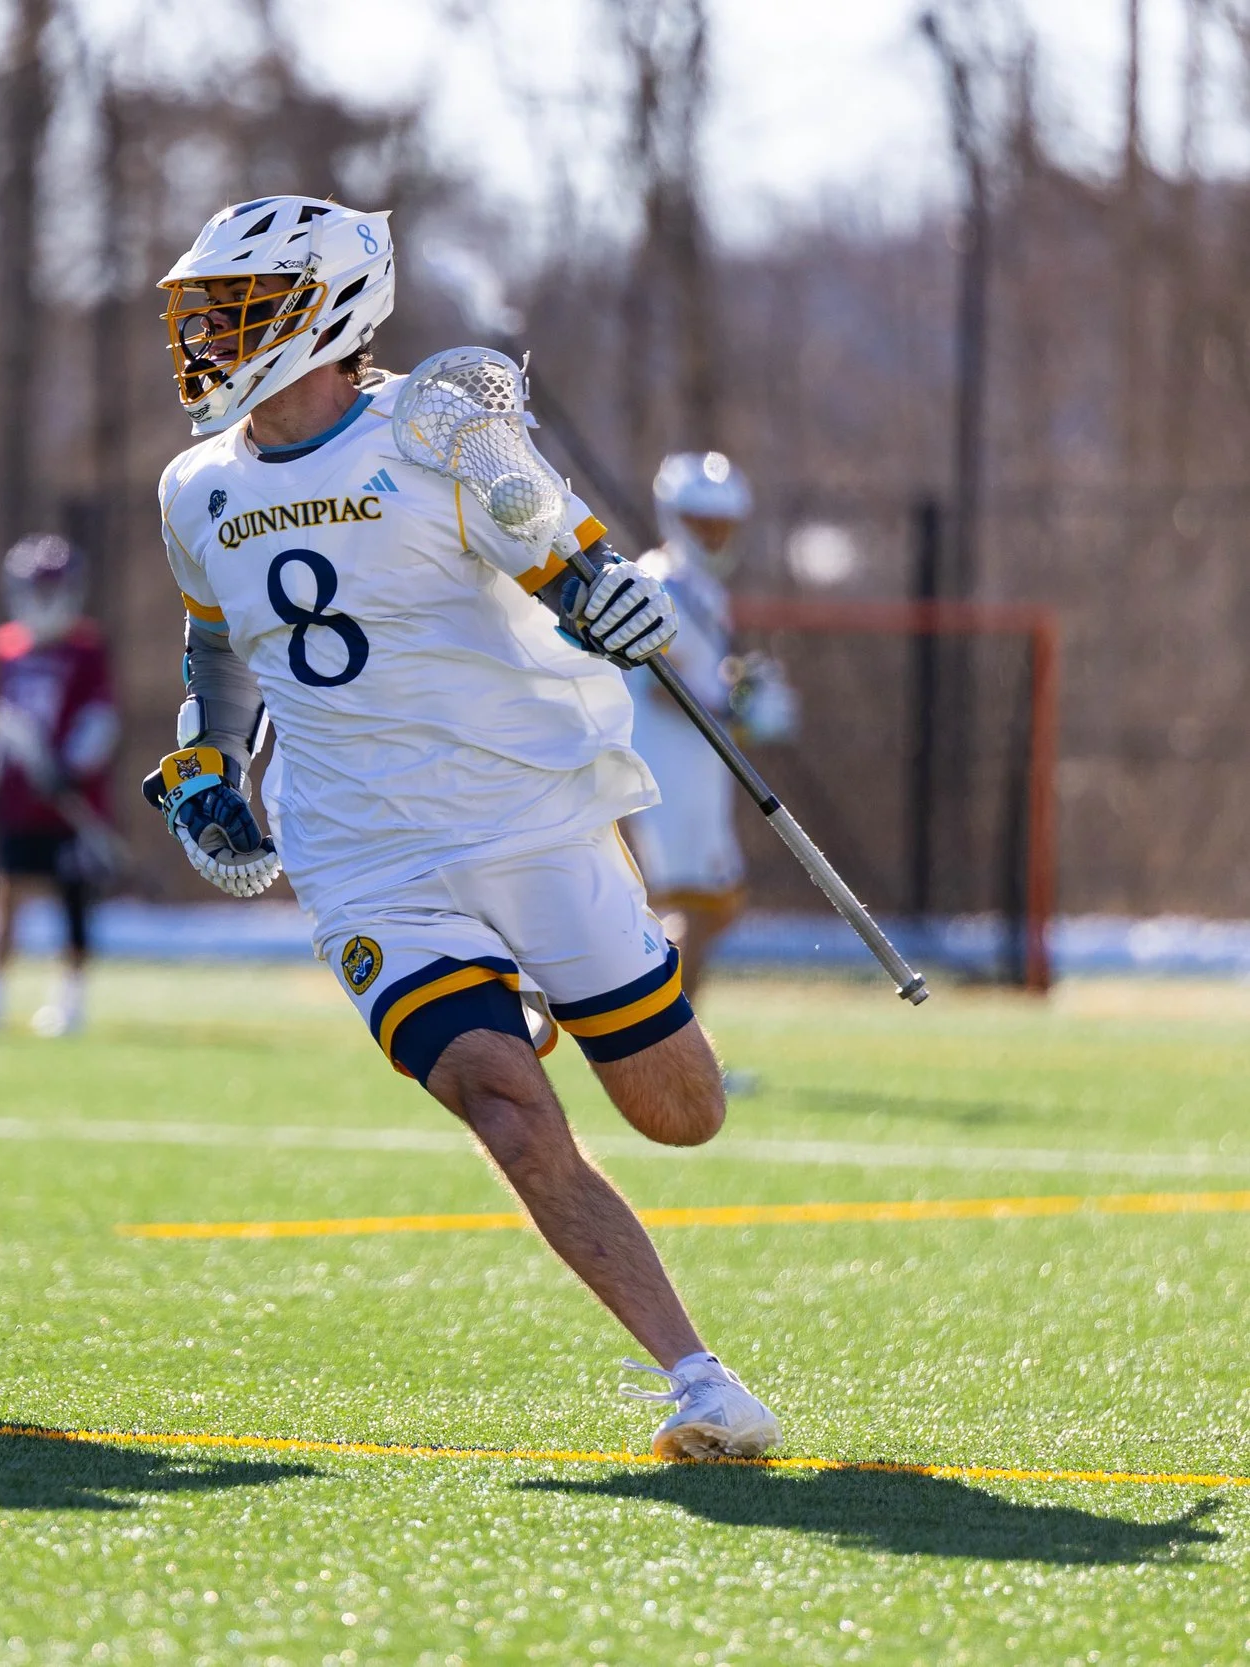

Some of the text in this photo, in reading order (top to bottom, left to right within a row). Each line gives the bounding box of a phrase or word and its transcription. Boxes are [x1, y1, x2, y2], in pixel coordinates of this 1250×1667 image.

[356, 223, 378, 255] 8
[217, 496, 383, 550] QUINNIPIAC
[266, 548, 370, 688] 8
